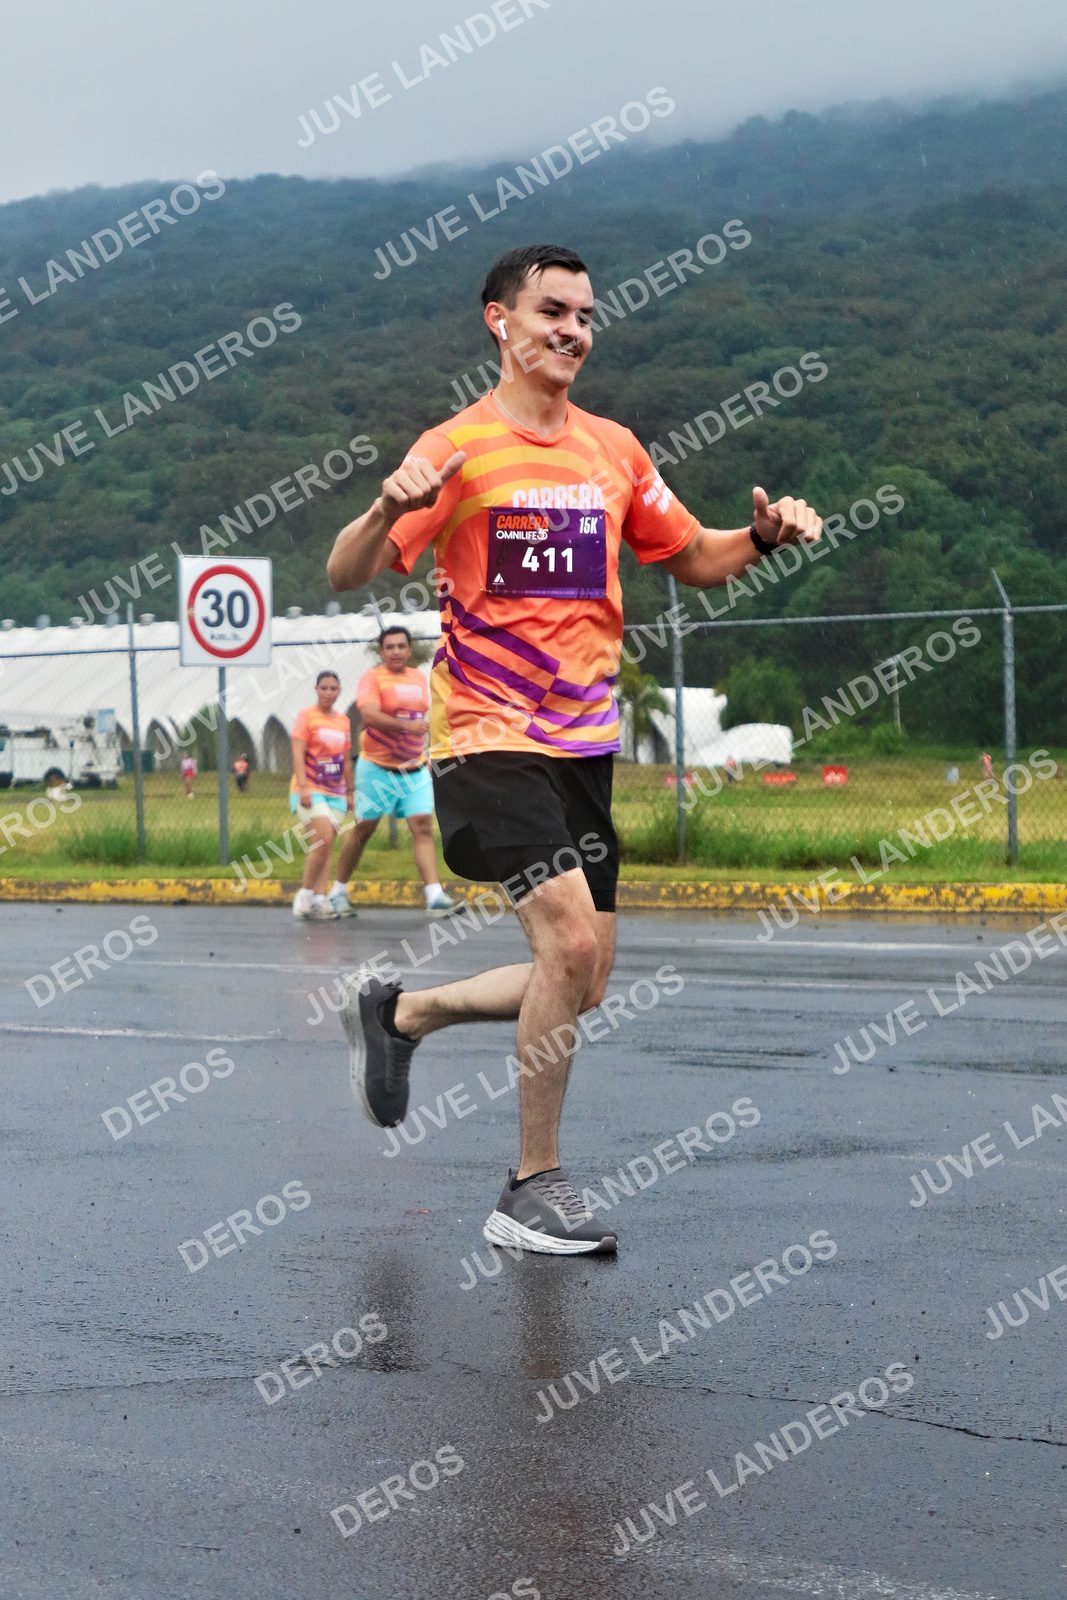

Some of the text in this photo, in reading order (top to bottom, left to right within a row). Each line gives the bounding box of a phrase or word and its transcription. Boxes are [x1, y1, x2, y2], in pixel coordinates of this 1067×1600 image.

[512, 483, 604, 509] CARRERA
[496, 514, 549, 530] CARRERA
[579, 516, 599, 535] 15K
[521, 546, 574, 573] 411
[201, 588, 250, 629] 30
